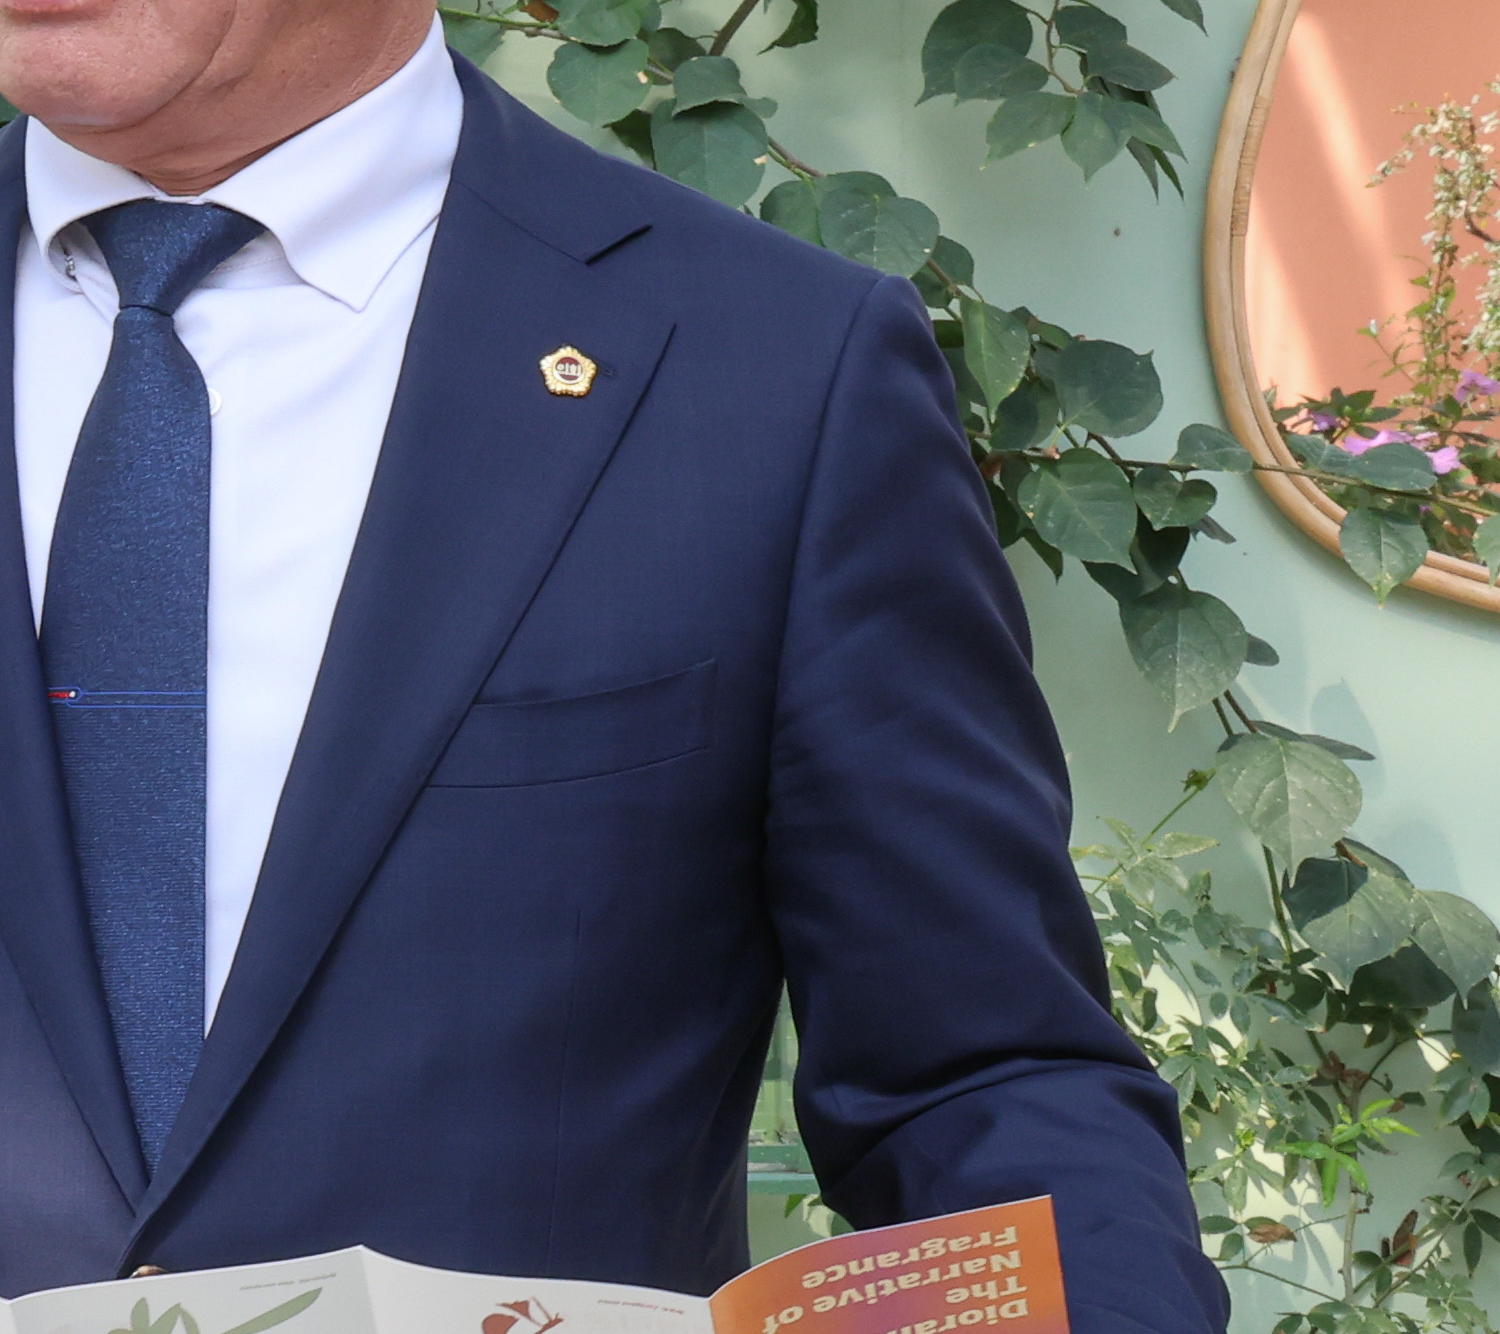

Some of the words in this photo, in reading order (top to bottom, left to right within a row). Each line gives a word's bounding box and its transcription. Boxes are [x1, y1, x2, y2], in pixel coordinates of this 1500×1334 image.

[801, 1225, 1019, 1289] Fragrance
[812, 1250, 1022, 1314] Narrative
[945, 1275, 1027, 1304] The
